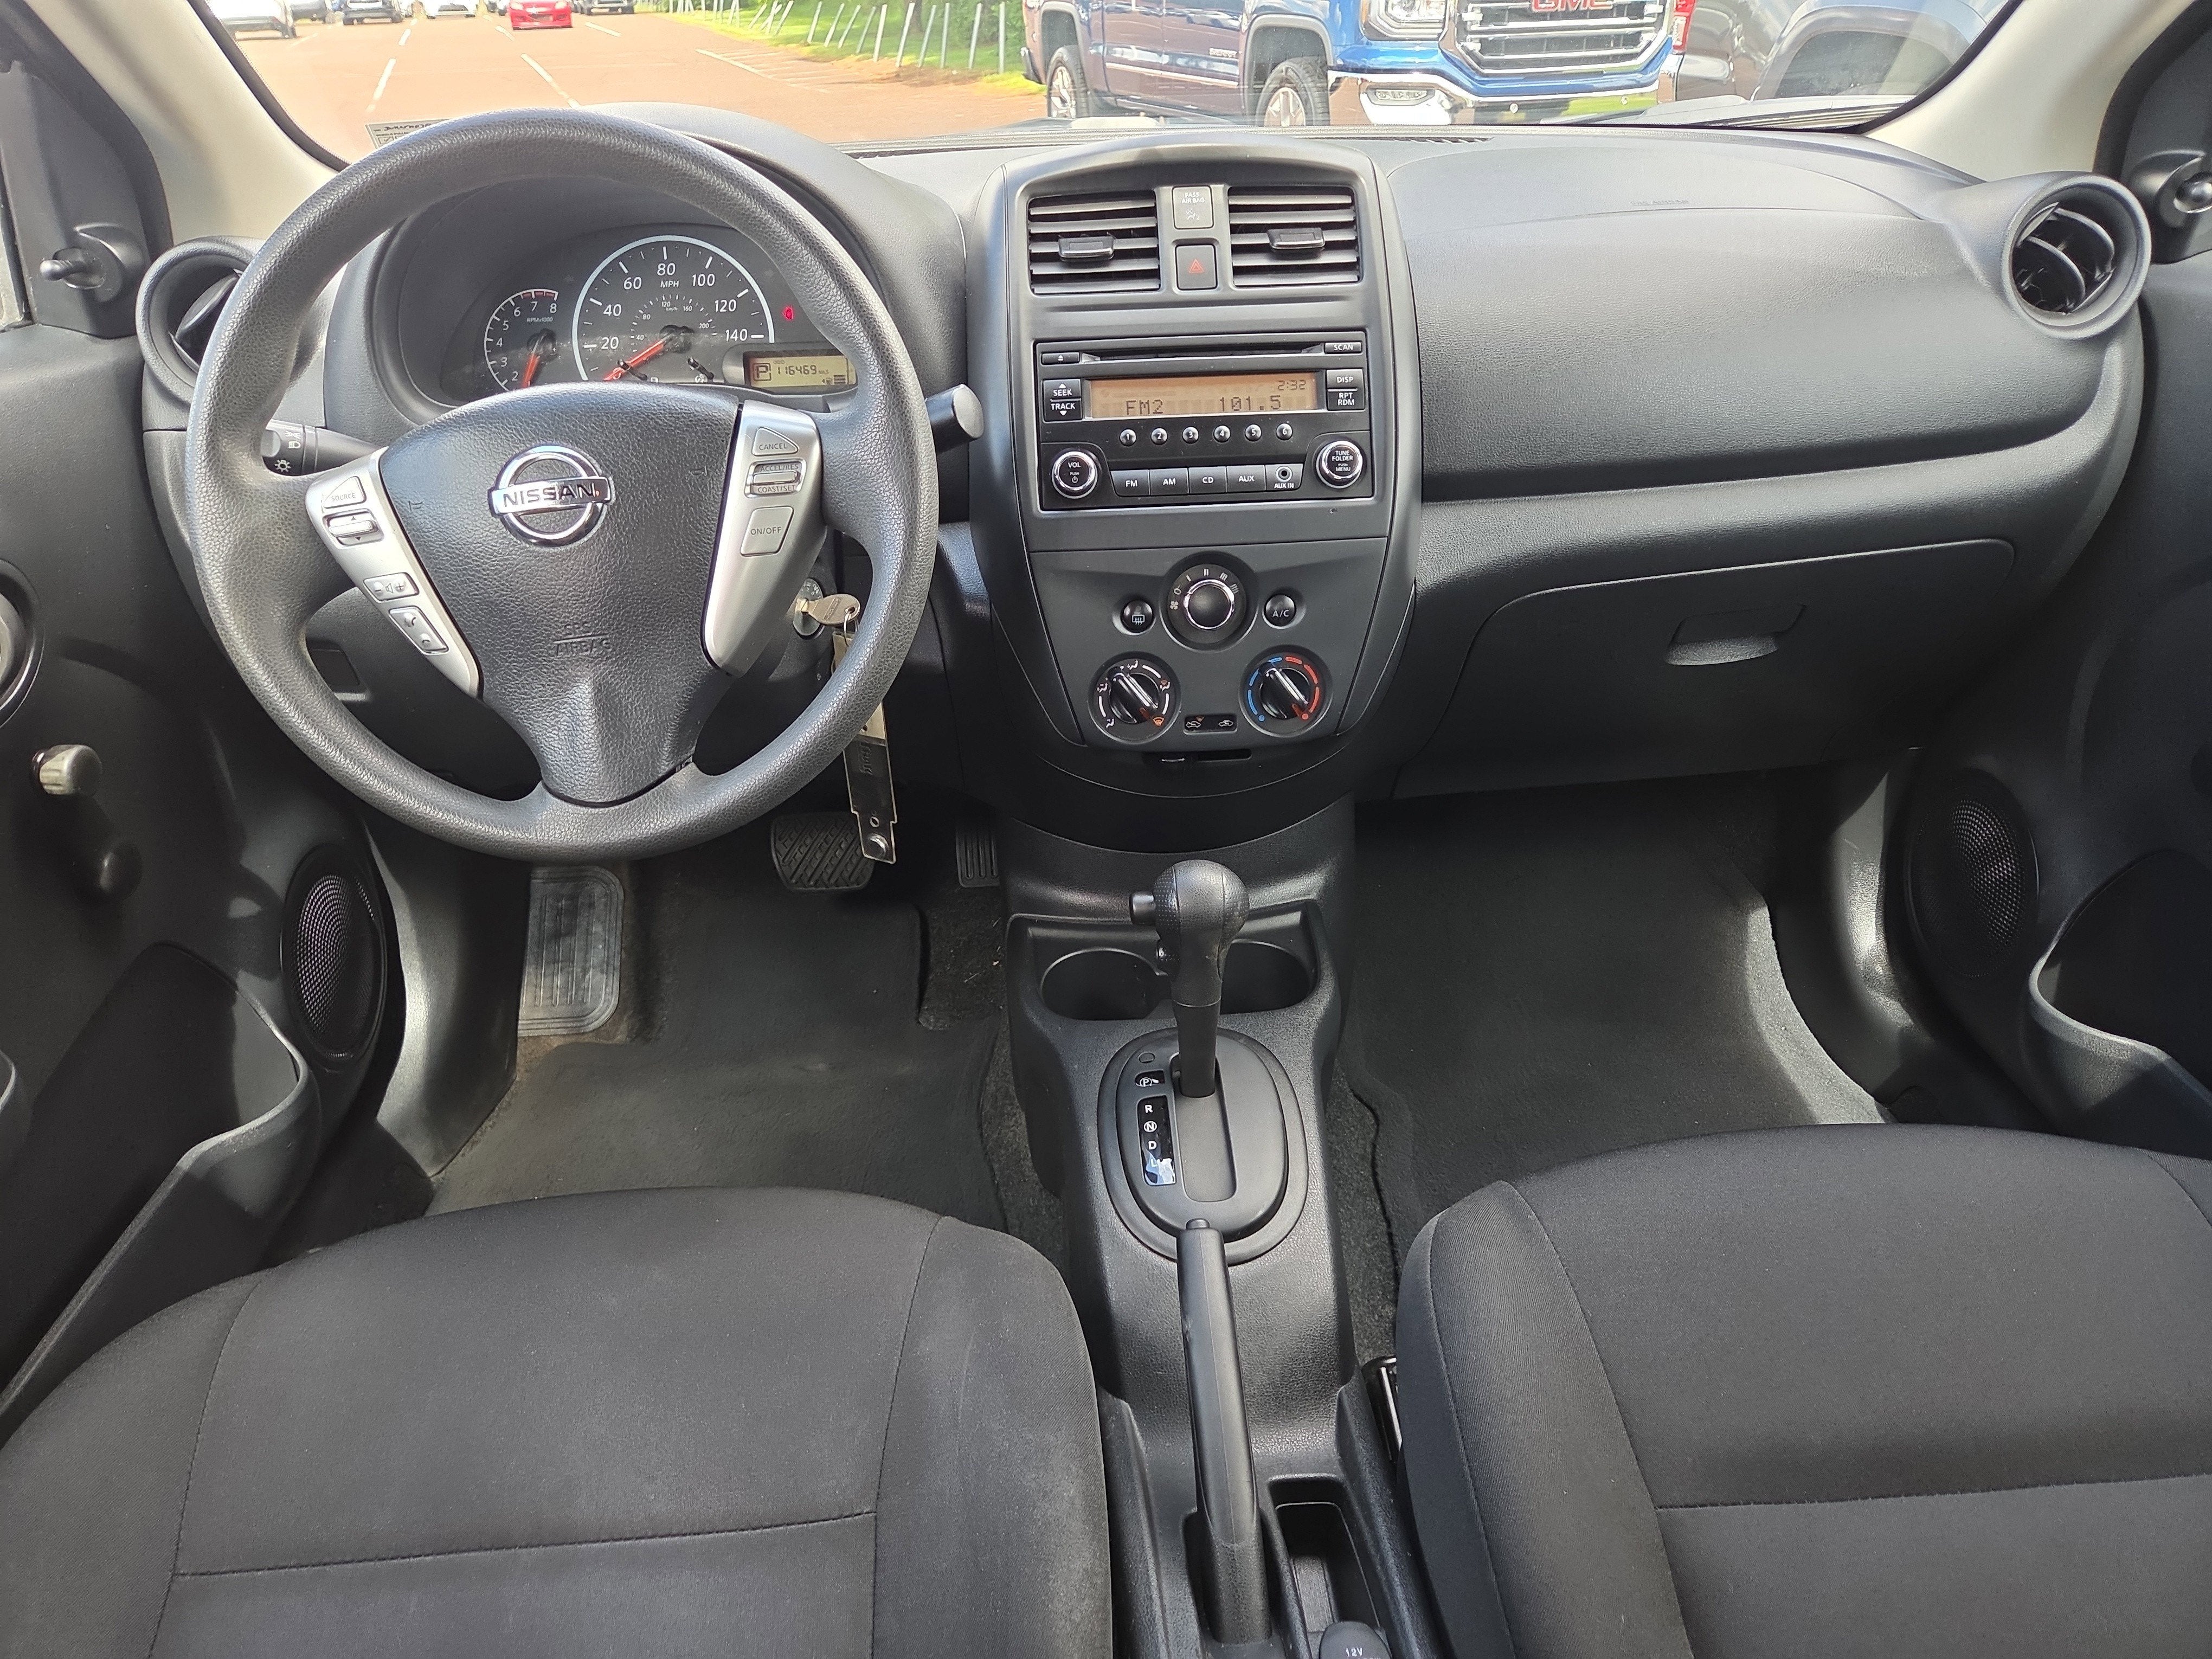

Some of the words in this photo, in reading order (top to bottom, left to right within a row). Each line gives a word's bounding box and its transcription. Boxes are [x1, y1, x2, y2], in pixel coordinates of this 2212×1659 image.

[657, 263, 676, 276] 80
[623, 276, 642, 290] 60
[660, 280, 679, 288] MPH
[692, 273, 715, 287] 100
[531, 301, 538, 311] 7
[550, 303, 557, 313] 8
[603, 304, 622, 317] 40
[715, 299, 736, 313] 120
[514, 307, 520, 317] 6
[502, 320, 509, 331] 5
[725, 329, 748, 342] 140
[496, 337, 503, 347] 4
[601, 337, 619, 349] 20
[501, 357, 507, 368] 3
[757, 365, 769, 378] P
[777, 365, 817, 375] 116469
[512, 371, 518, 381] 2
[1278, 380, 1306, 390] 2:32
[1051, 402, 1076, 410] TRACK
[1126, 400, 1163, 415] FM2
[1220, 395, 1281, 411] 101.5
[760, 464, 799, 472] ACCEL/RES
[757, 485, 796, 493] COAST/SET
[331, 493, 356, 502] SOURCE
[503, 483, 596, 507] NISSAN
[750, 526, 782, 536] ON/OFF
[1272, 610, 1289, 618] A/C
[1145, 1105, 1153, 1114] R
[1146, 1123, 1154, 1131] N
[1148, 1141, 1157, 1150] D
[1346, 1647, 1362, 1657] 12V
